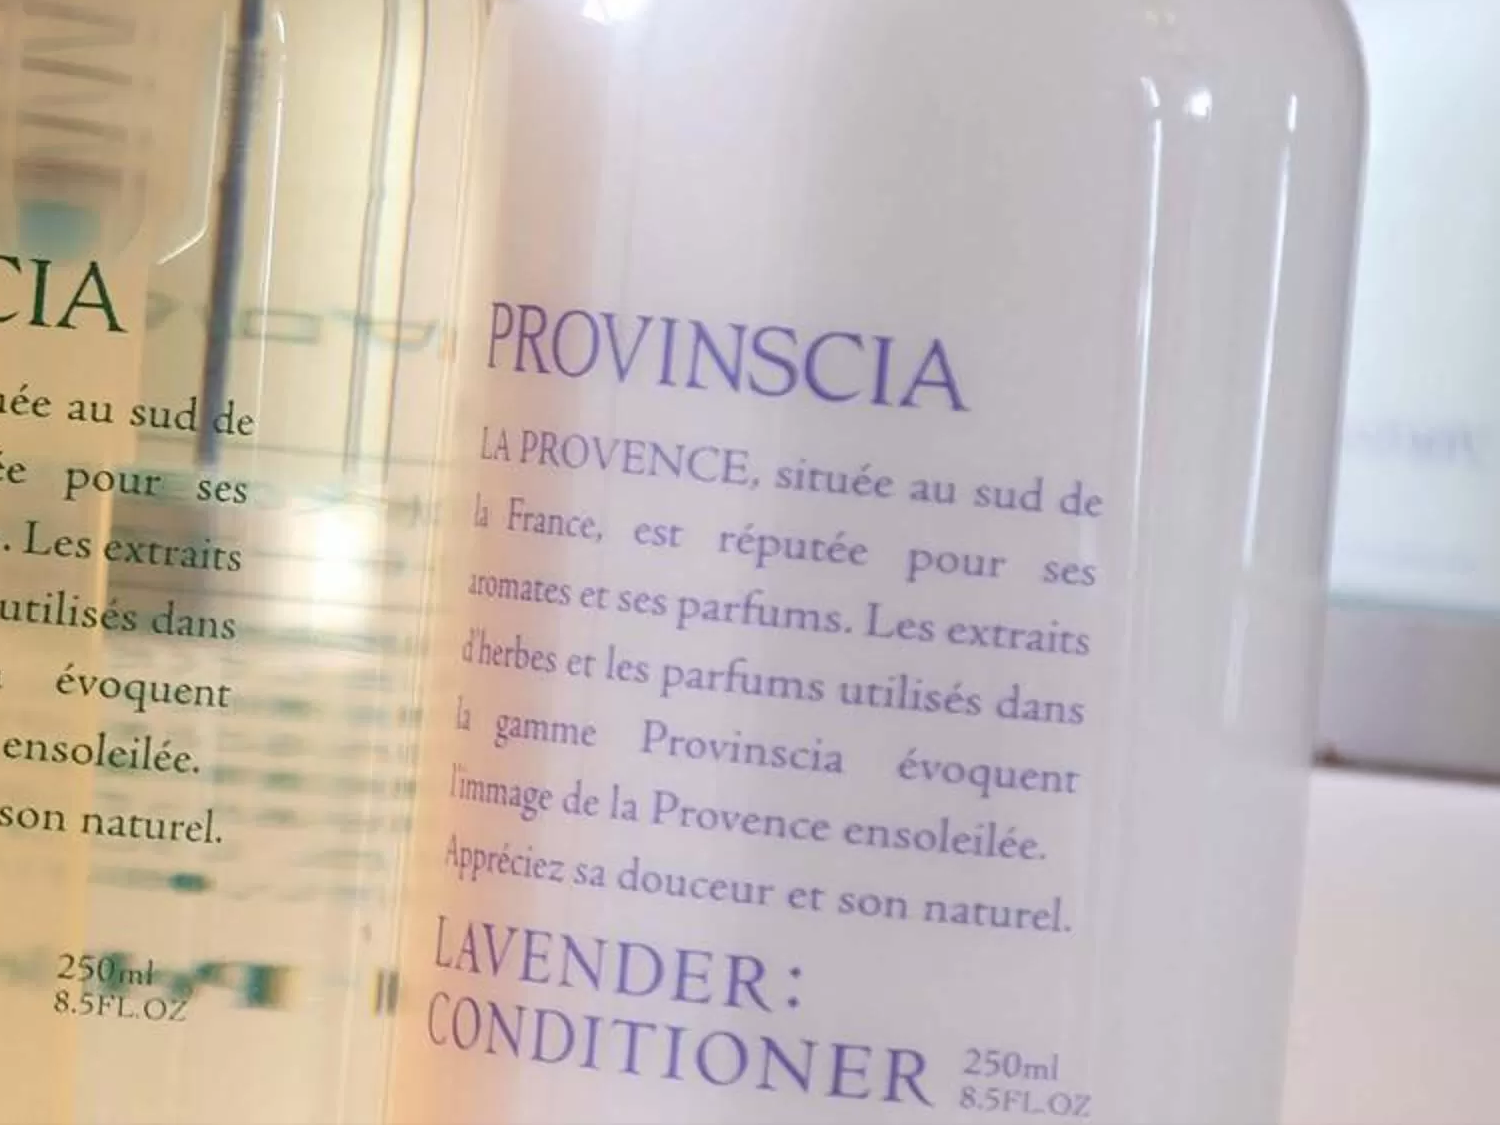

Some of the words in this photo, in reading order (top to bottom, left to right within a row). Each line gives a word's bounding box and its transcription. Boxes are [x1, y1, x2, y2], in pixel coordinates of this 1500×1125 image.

[487, 302, 971, 413] PROVINSCIA
[67, 395, 114, 423] au
[130, 395, 198, 433] sud
[213, 399, 254, 437] de
[64, 466, 162, 501] pour
[197, 476, 247, 504] ses
[481, 426, 510, 462] LA
[520, 428, 760, 491] PROVENCE,
[776, 461, 893, 499] située
[909, 476, 955, 505] au
[973, 475, 1043, 513] sud
[1060, 481, 1103, 519] de
[23, 520, 91, 561] Les
[104, 534, 243, 573] extraits
[474, 492, 489, 529] la
[507, 496, 602, 543] France,
[634, 521, 683, 549] est
[719, 525, 869, 568] réputée
[907, 546, 1006, 582] pour
[1043, 559, 1097, 588] ses
[152, 602, 237, 641] dans
[469, 571, 571, 607] aromates
[579, 584, 609, 610] et
[617, 587, 667, 616] ses
[677, 589, 854, 635] parfums.
[866, 602, 936, 644] Les
[947, 617, 1091, 657] extraits
[56, 664, 231, 714] évoquent
[566, 650, 597, 677] et
[606, 644, 650, 684] les
[661, 657, 825, 698] parfums
[839, 673, 982, 717] utilisés
[996, 684, 1086, 726] dans
[2, 731, 200, 775] ensoleilée.
[456, 694, 470, 731] la
[495, 711, 596, 747] gamme
[641, 719, 844, 774] Provinscia
[897, 748, 1081, 799] évoquent
[80, 809, 223, 845] naturel.
[562, 778, 599, 816] de
[610, 784, 639, 822] la
[653, 788, 831, 843] Provence
[844, 815, 1047, 861] ensoleilée.
[446, 834, 564, 883] Appréciez
[573, 860, 606, 888] sa
[618, 856, 775, 907] douceur
[788, 884, 823, 912] et
[838, 891, 907, 921] son
[923, 897, 1071, 935] naturel.
[56, 952, 154, 986] 250ml
[427, 990, 936, 1109] CONDITIONER
[962, 1047, 1060, 1084] 250ml
